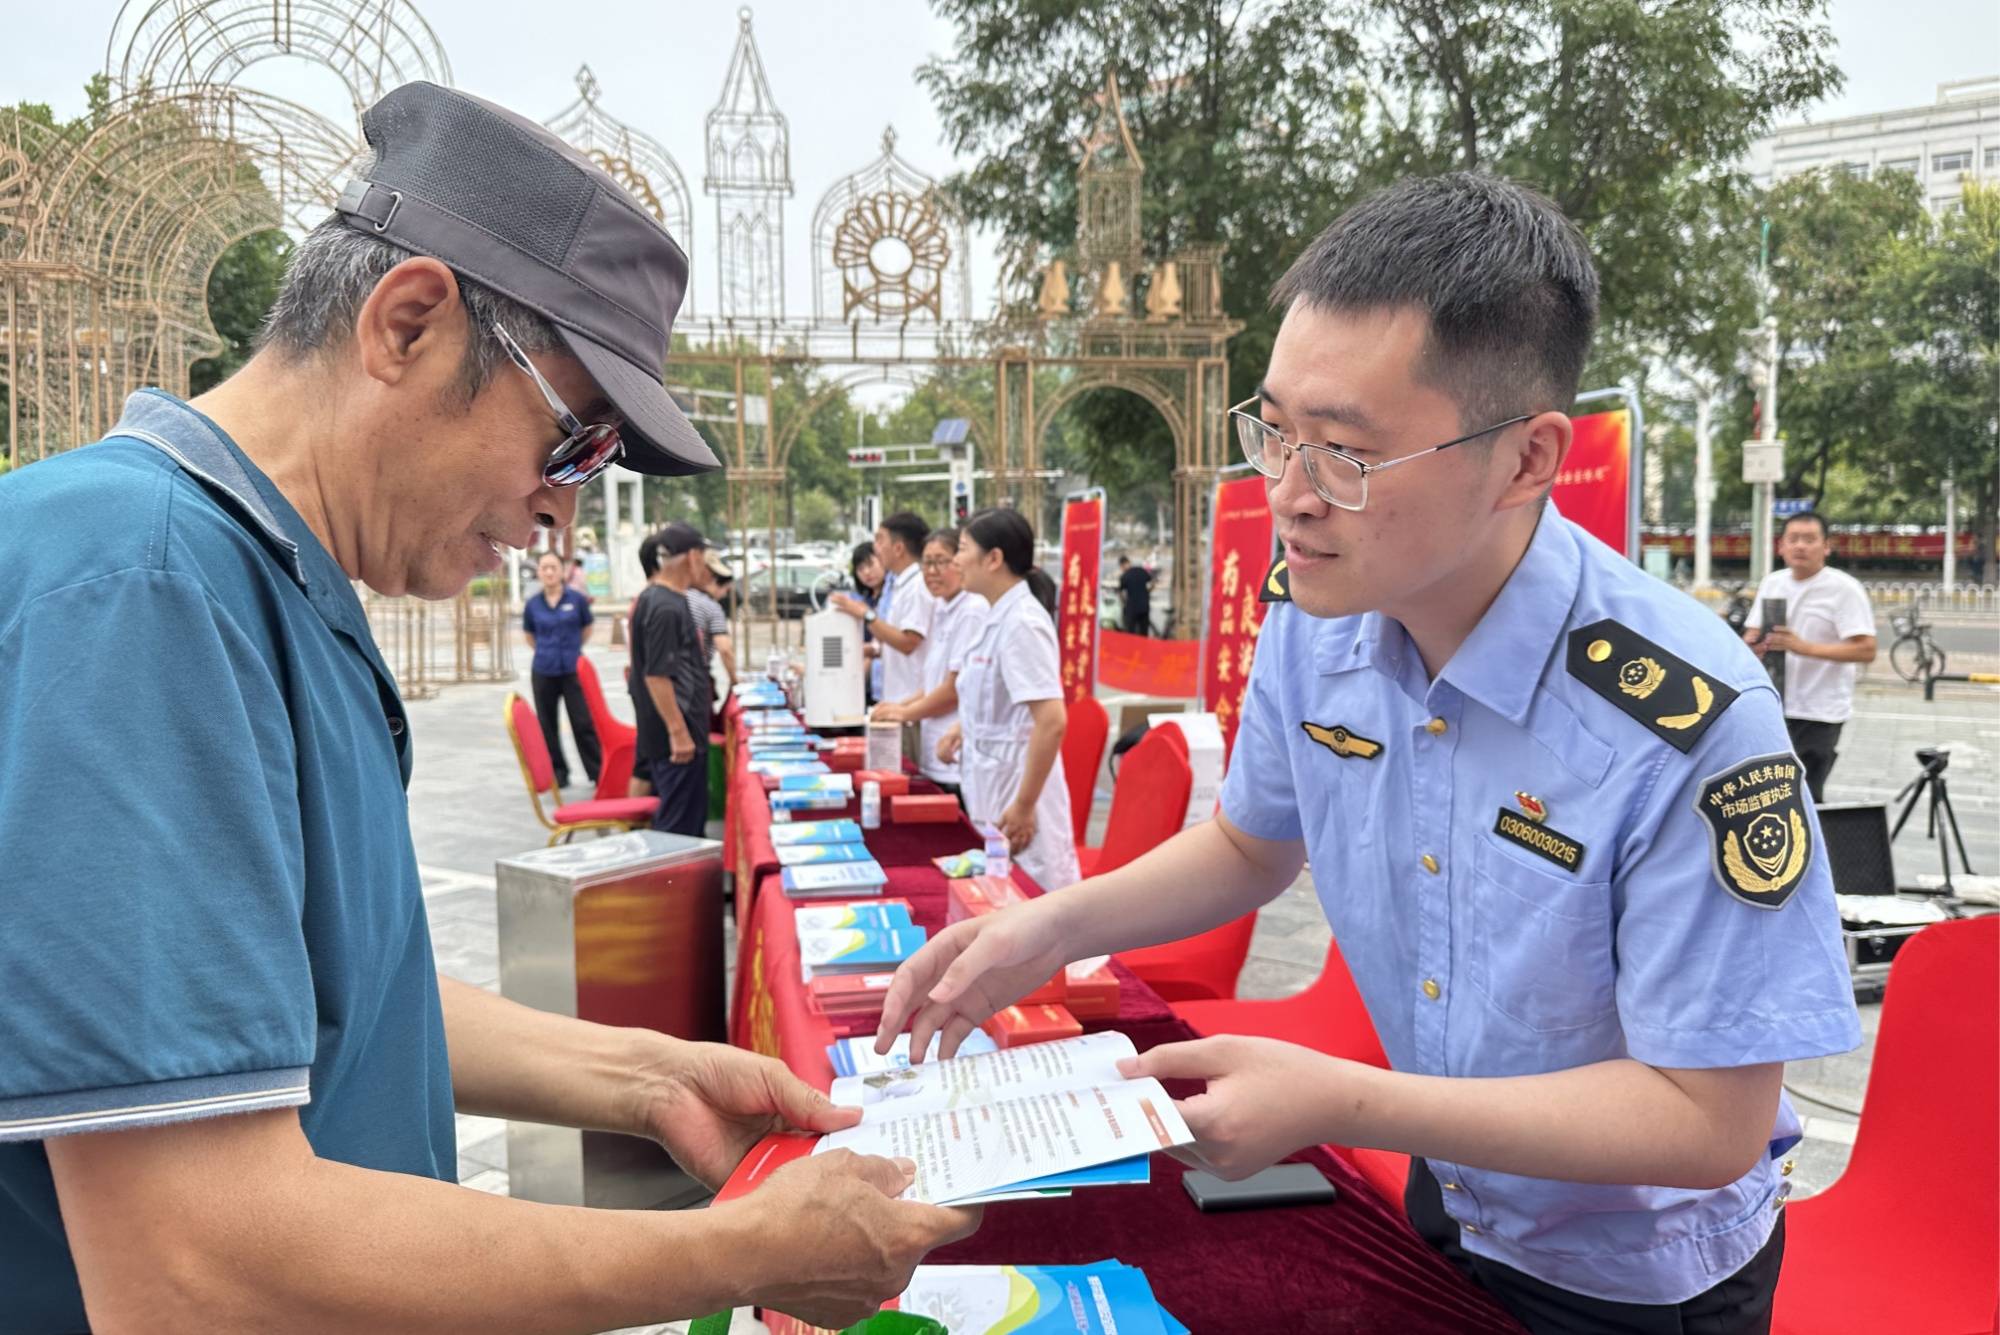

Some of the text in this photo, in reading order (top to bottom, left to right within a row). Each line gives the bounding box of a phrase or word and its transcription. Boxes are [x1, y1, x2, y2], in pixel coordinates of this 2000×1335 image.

[1215, 549, 1241, 733] 药品安全
[1709, 764, 1796, 807] 中华人民共和国
[1720, 782, 1793, 819] 市场监管执法
[1500, 815, 1578, 864] 03060030215
